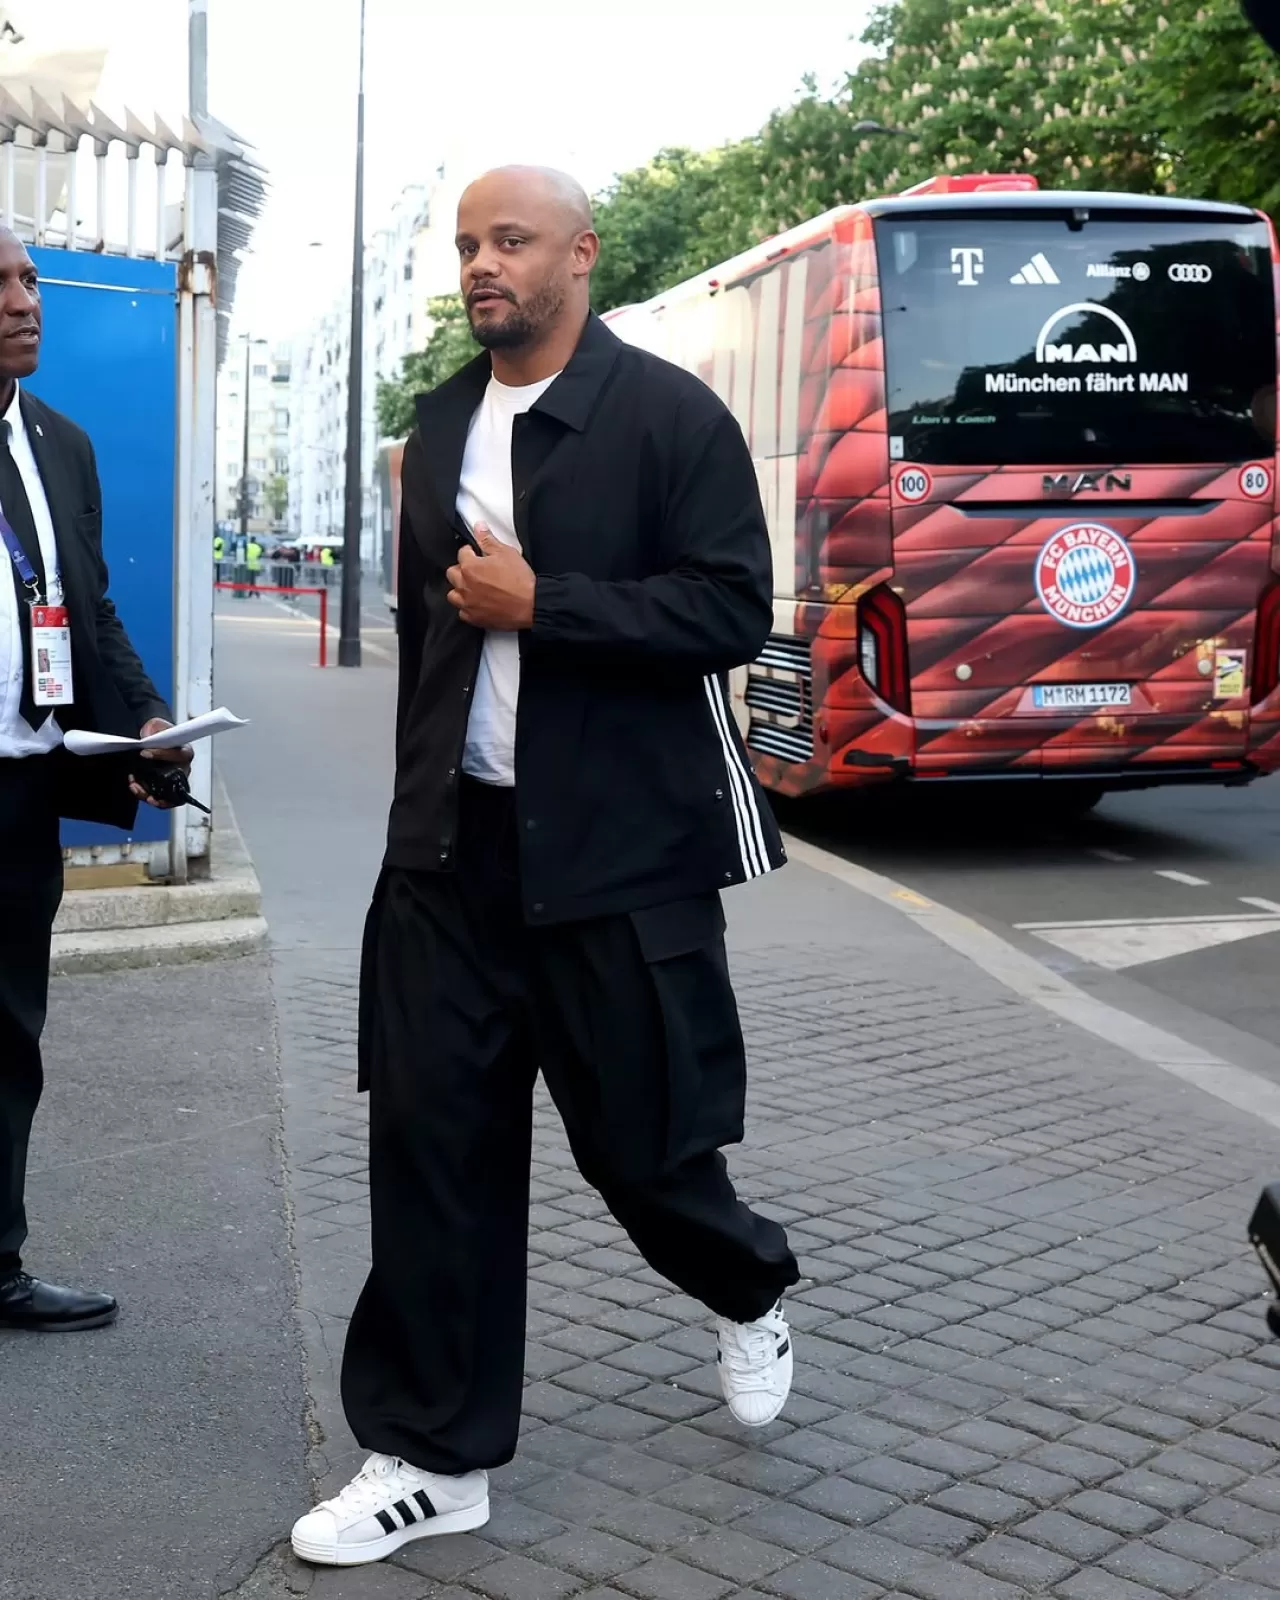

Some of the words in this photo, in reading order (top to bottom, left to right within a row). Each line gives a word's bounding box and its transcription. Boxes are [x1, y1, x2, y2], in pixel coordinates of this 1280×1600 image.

[951, 248, 984, 286] T
[1086, 264, 1132, 278] Allianz
[1045, 344, 1128, 363] MAN
[985, 373, 1081, 392] München
[1085, 373, 1135, 392] fährt
[1139, 373, 1188, 392] MAN
[901, 476, 926, 492] 100
[1042, 474, 1132, 493] MAN
[1246, 473, 1265, 488] 80
[1042, 543, 1065, 569] FC
[1062, 529, 1129, 568] BAYERN
